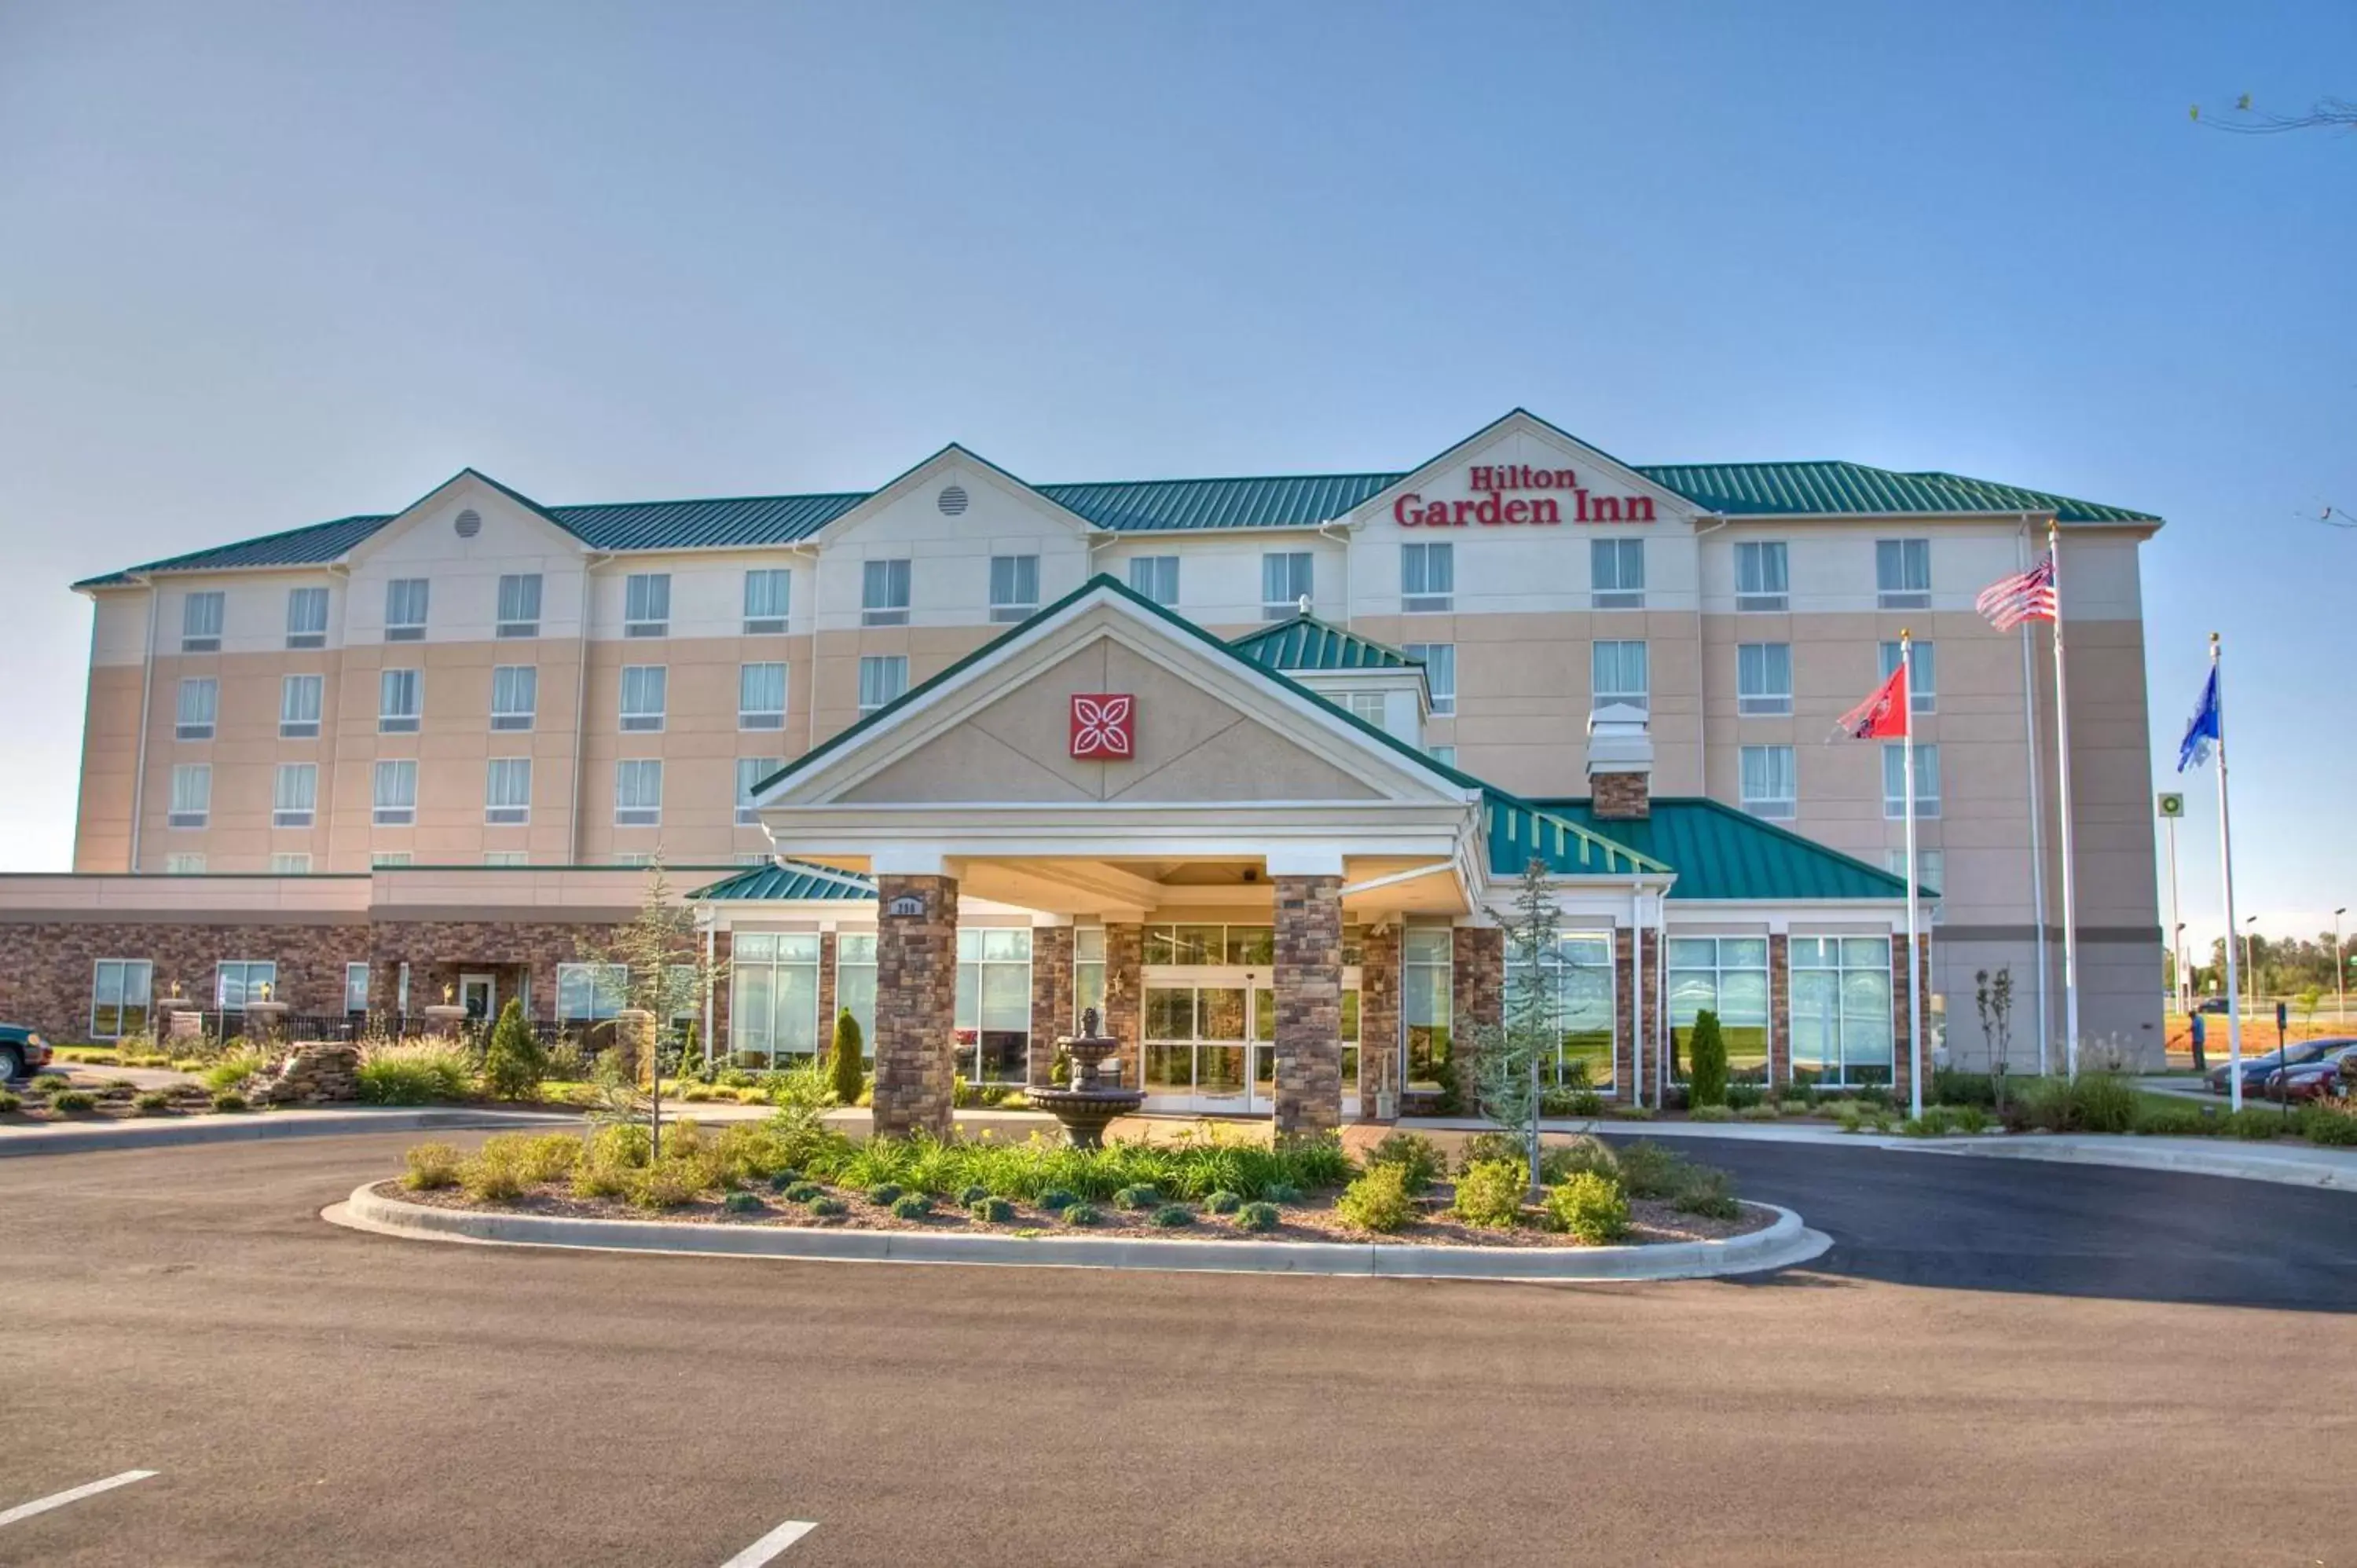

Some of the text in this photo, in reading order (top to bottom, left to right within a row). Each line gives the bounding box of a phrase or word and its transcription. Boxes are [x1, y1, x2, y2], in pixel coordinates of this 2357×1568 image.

[1470, 465, 1578, 491] Hilton
[1394, 489, 1656, 527] Garden Inn
